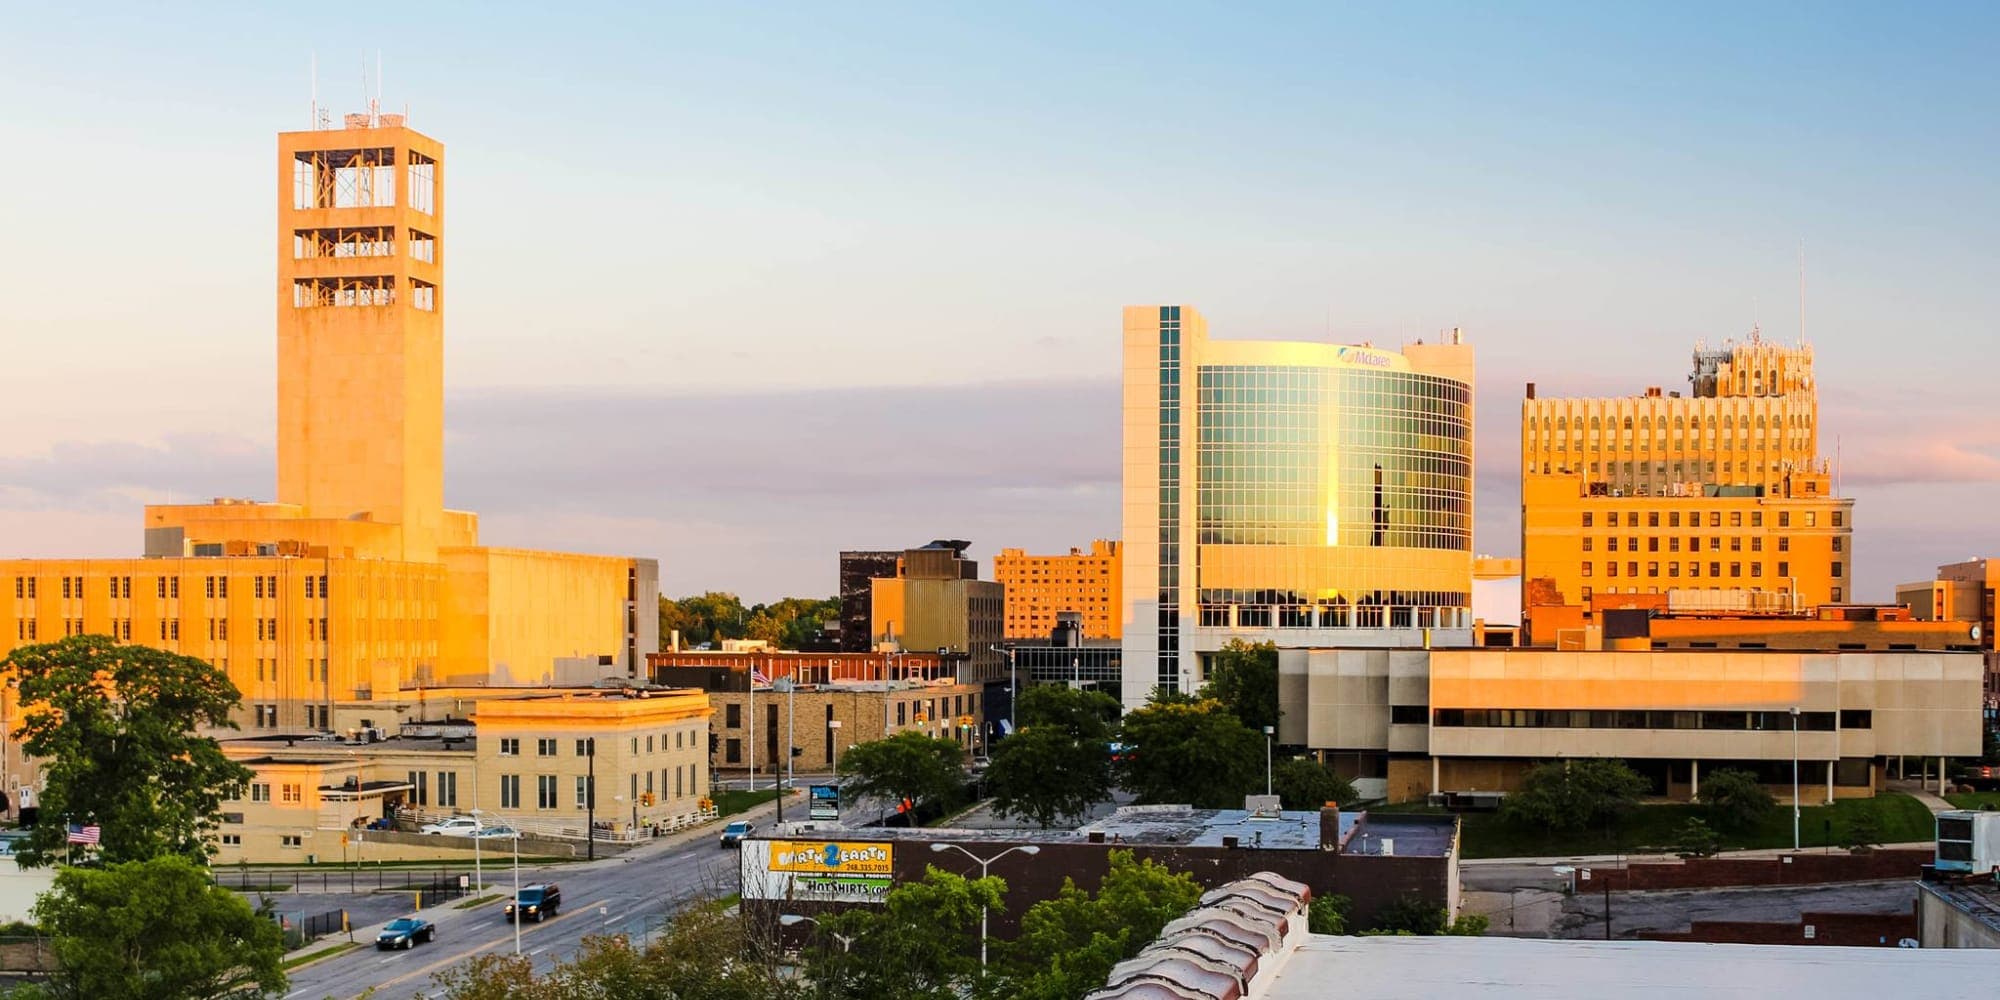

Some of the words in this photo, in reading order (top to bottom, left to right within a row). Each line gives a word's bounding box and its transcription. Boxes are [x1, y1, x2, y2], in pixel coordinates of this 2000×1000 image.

[1354, 351, 1391, 368] McLaren
[824, 844, 840, 867] 2
[841, 847, 886, 862] EARTH
